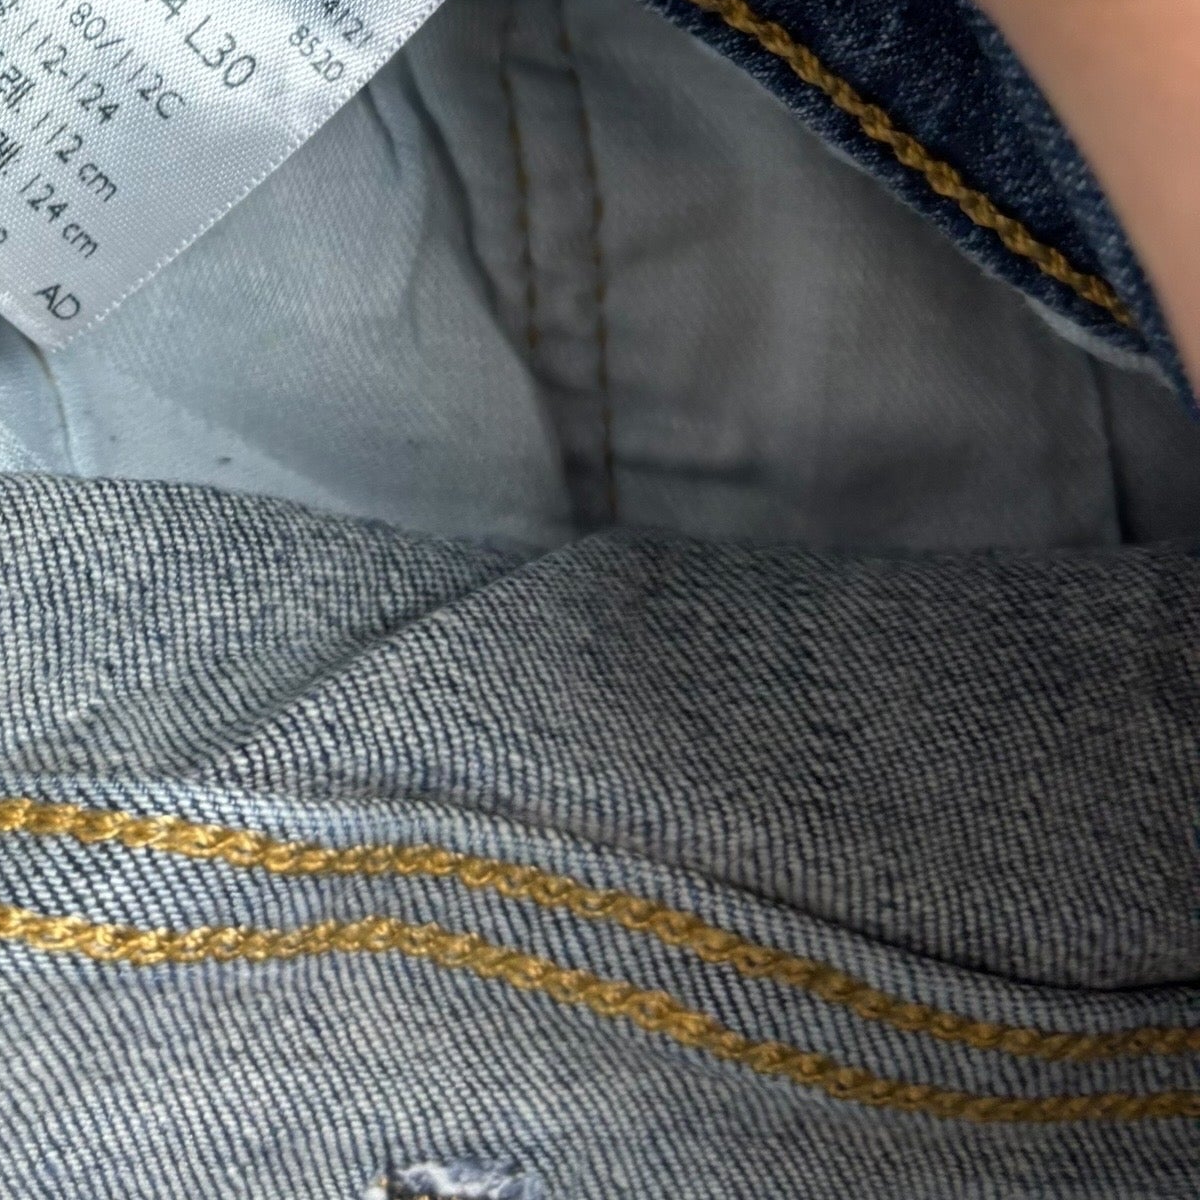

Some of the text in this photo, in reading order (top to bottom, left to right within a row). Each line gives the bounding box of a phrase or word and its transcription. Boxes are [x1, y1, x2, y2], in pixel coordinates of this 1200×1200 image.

[15, 16, 122, 128] 112-124
[182, 13, 261, 93] L30
[286, 24, 348, 86] 8520
[30, 108, 84, 164] 112
[76, 157, 122, 204] cm
[18, 173, 70, 225] 124
[59, 218, 101, 260] cm
[34, 276, 84, 327] AD
